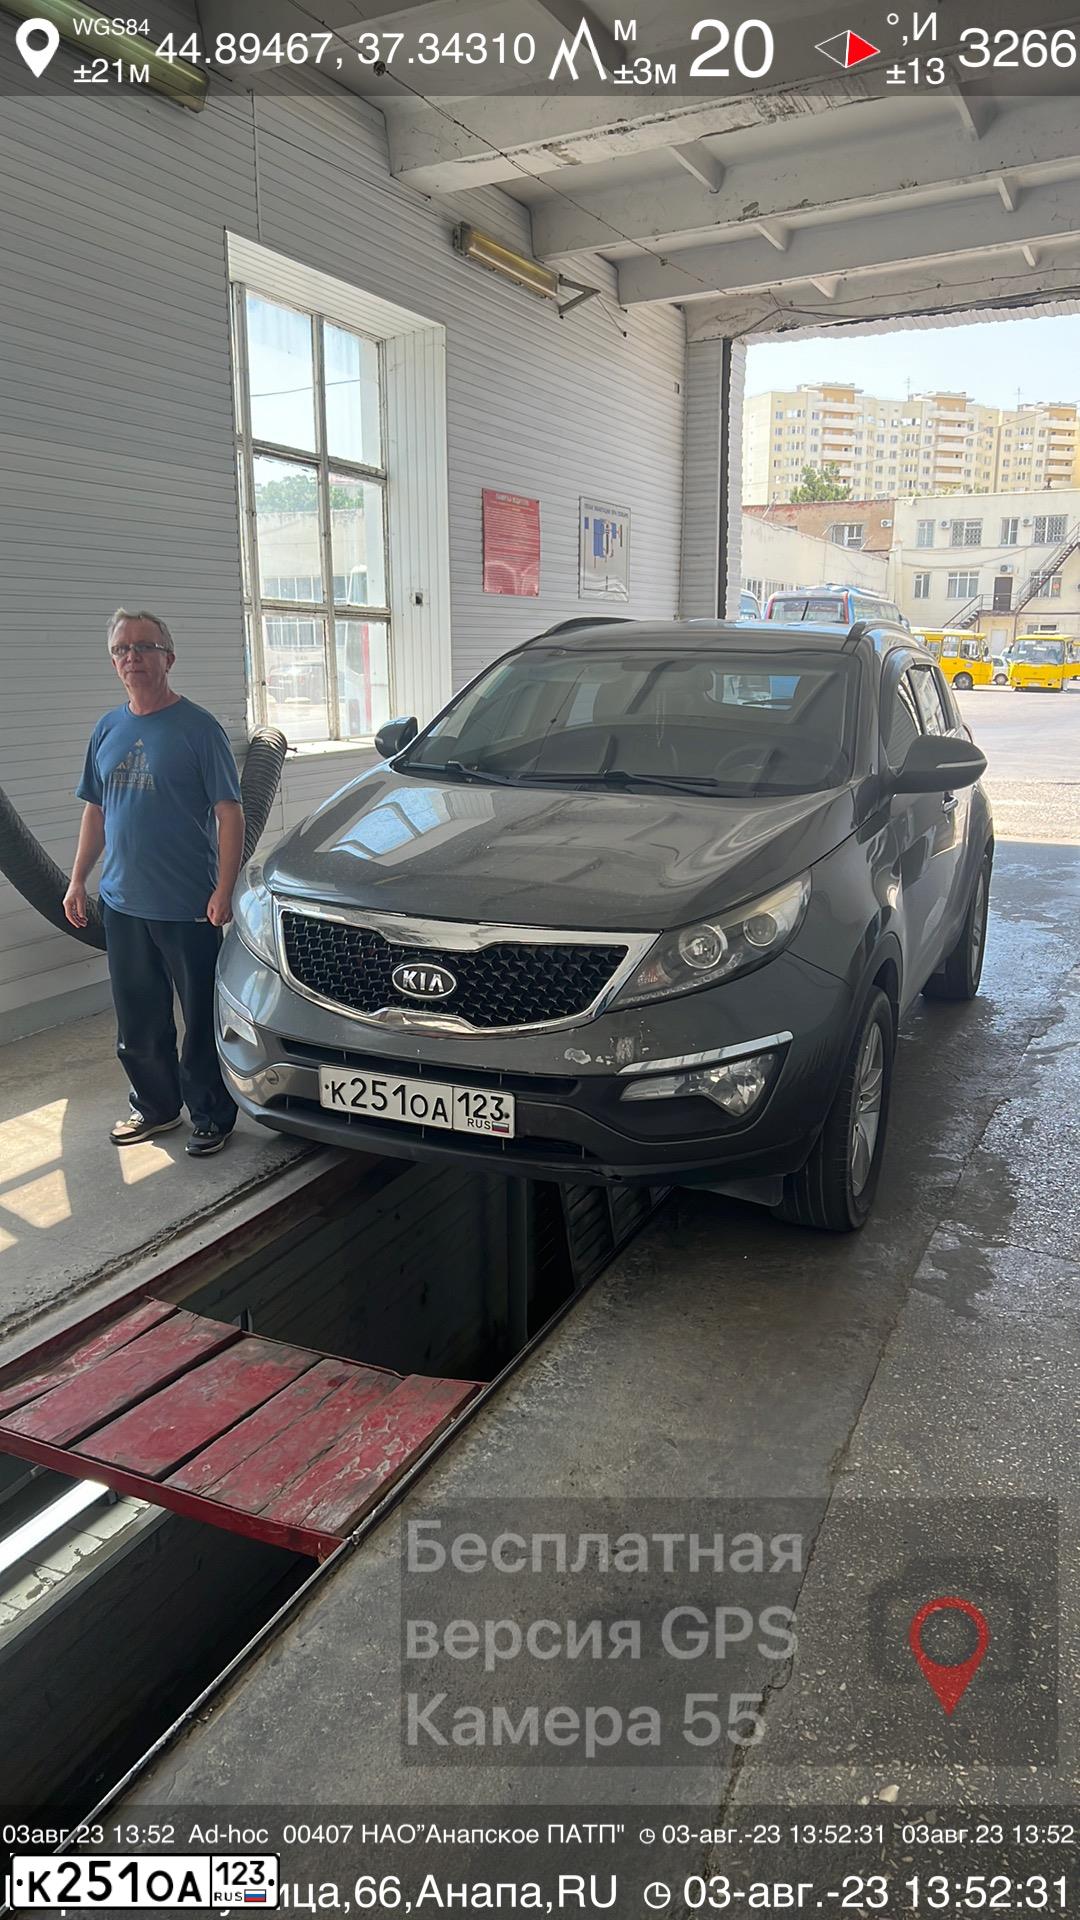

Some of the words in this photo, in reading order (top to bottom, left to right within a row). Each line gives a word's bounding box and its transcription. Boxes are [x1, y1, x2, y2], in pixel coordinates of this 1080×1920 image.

[402, 969, 445, 993] KIA
[331, 1077, 449, 1123] К251ОА
[457, 1091, 504, 1121] 123
[467, 1117, 492, 1130] RUS
